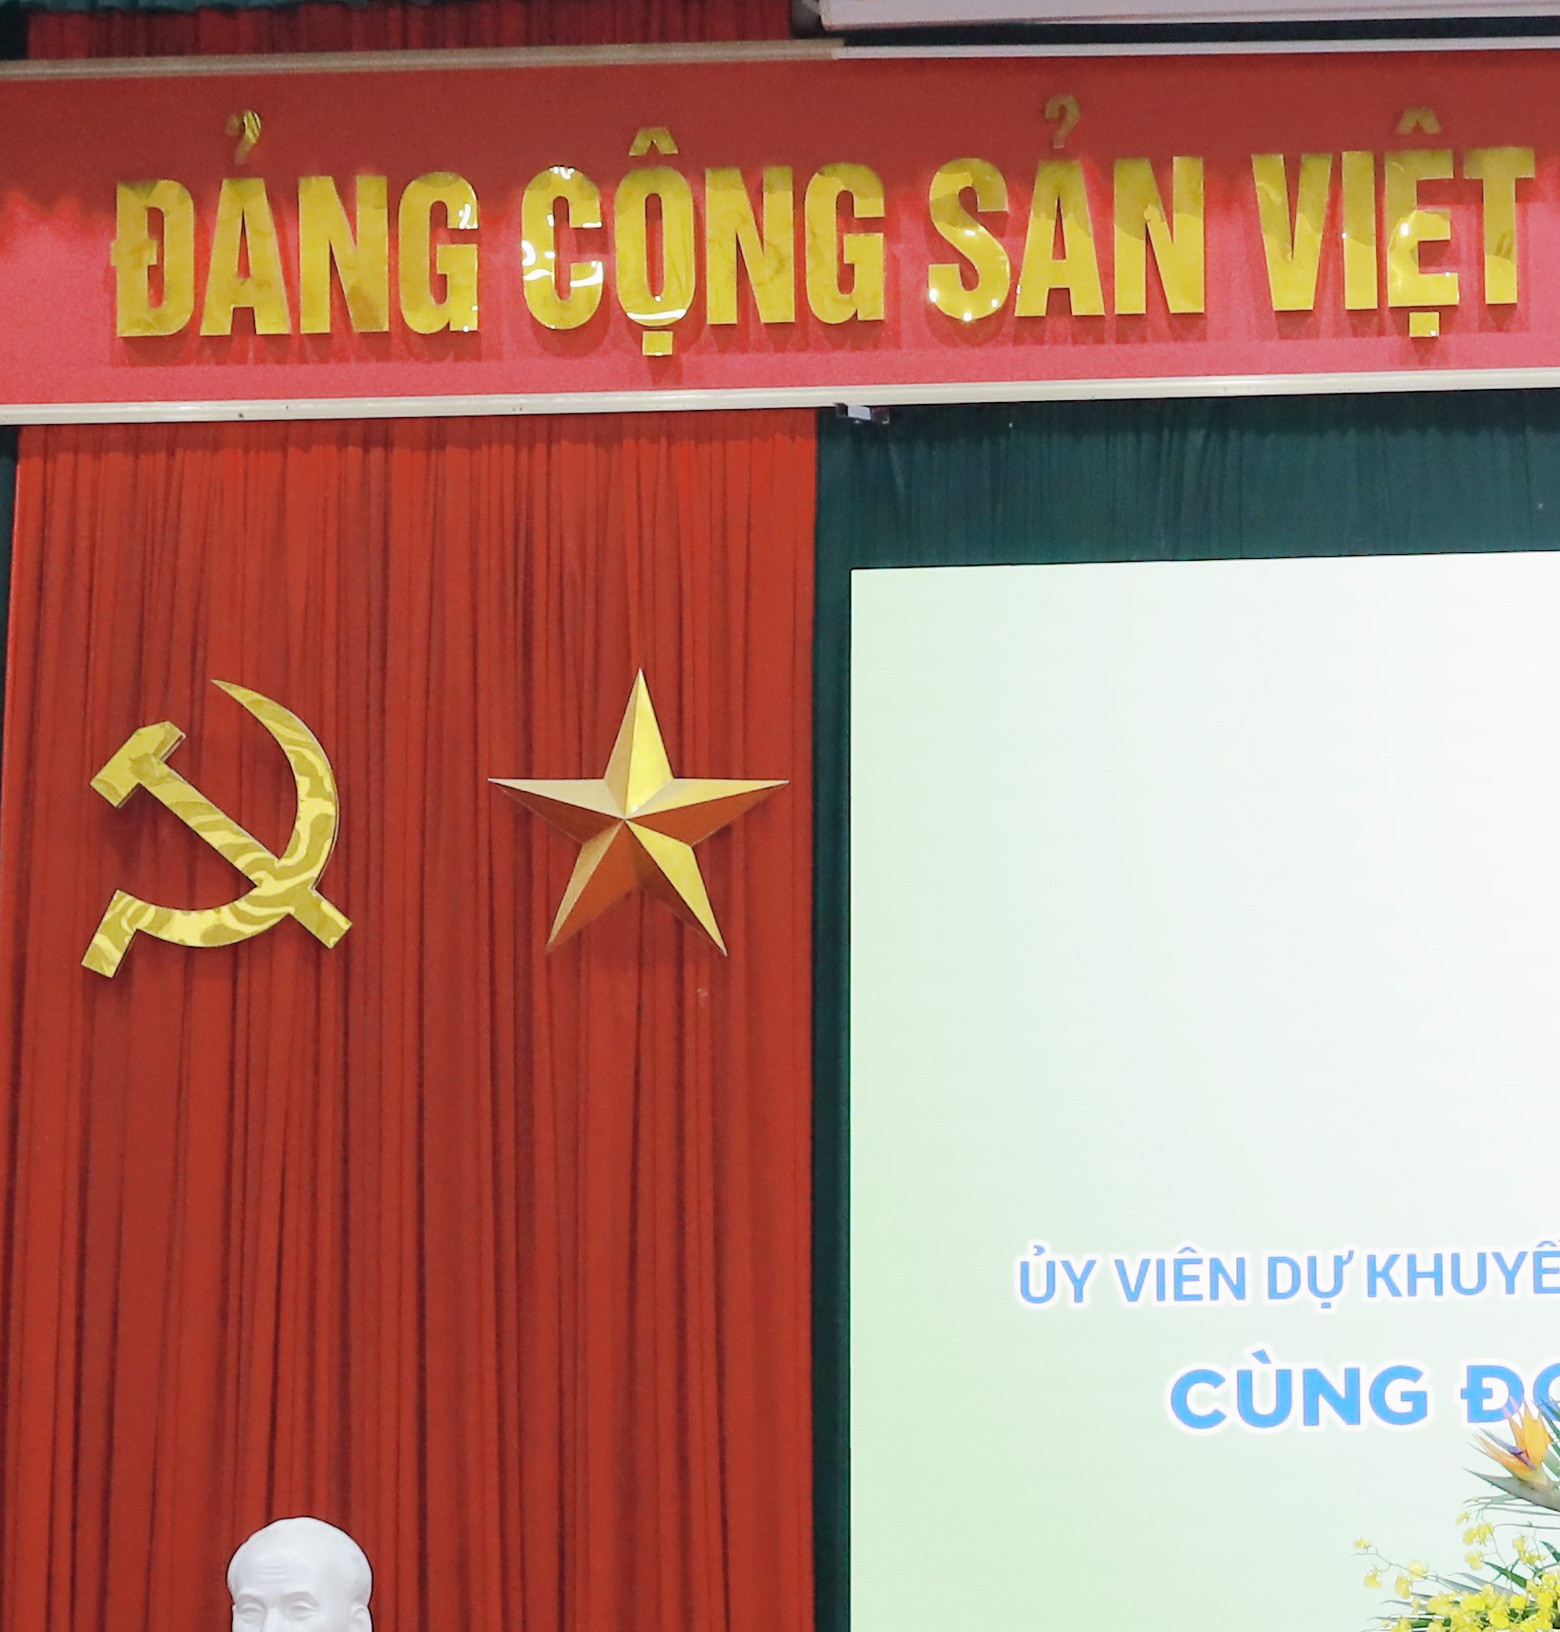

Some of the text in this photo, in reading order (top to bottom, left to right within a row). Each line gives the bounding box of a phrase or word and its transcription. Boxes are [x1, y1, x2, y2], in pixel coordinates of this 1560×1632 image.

[111, 108, 480, 341] ĐẢNG
[522, 124, 884, 358] CỘNG
[927, 94, 1208, 323] SẢN
[1248, 109, 1534, 341] VIỆT
[1019, 1245, 1097, 1304] ỦY
[1114, 1247, 1246, 1302] VIÊN
[1267, 1252, 1353, 1308] DỰ
[1171, 1350, 1427, 1429] CÙNG
